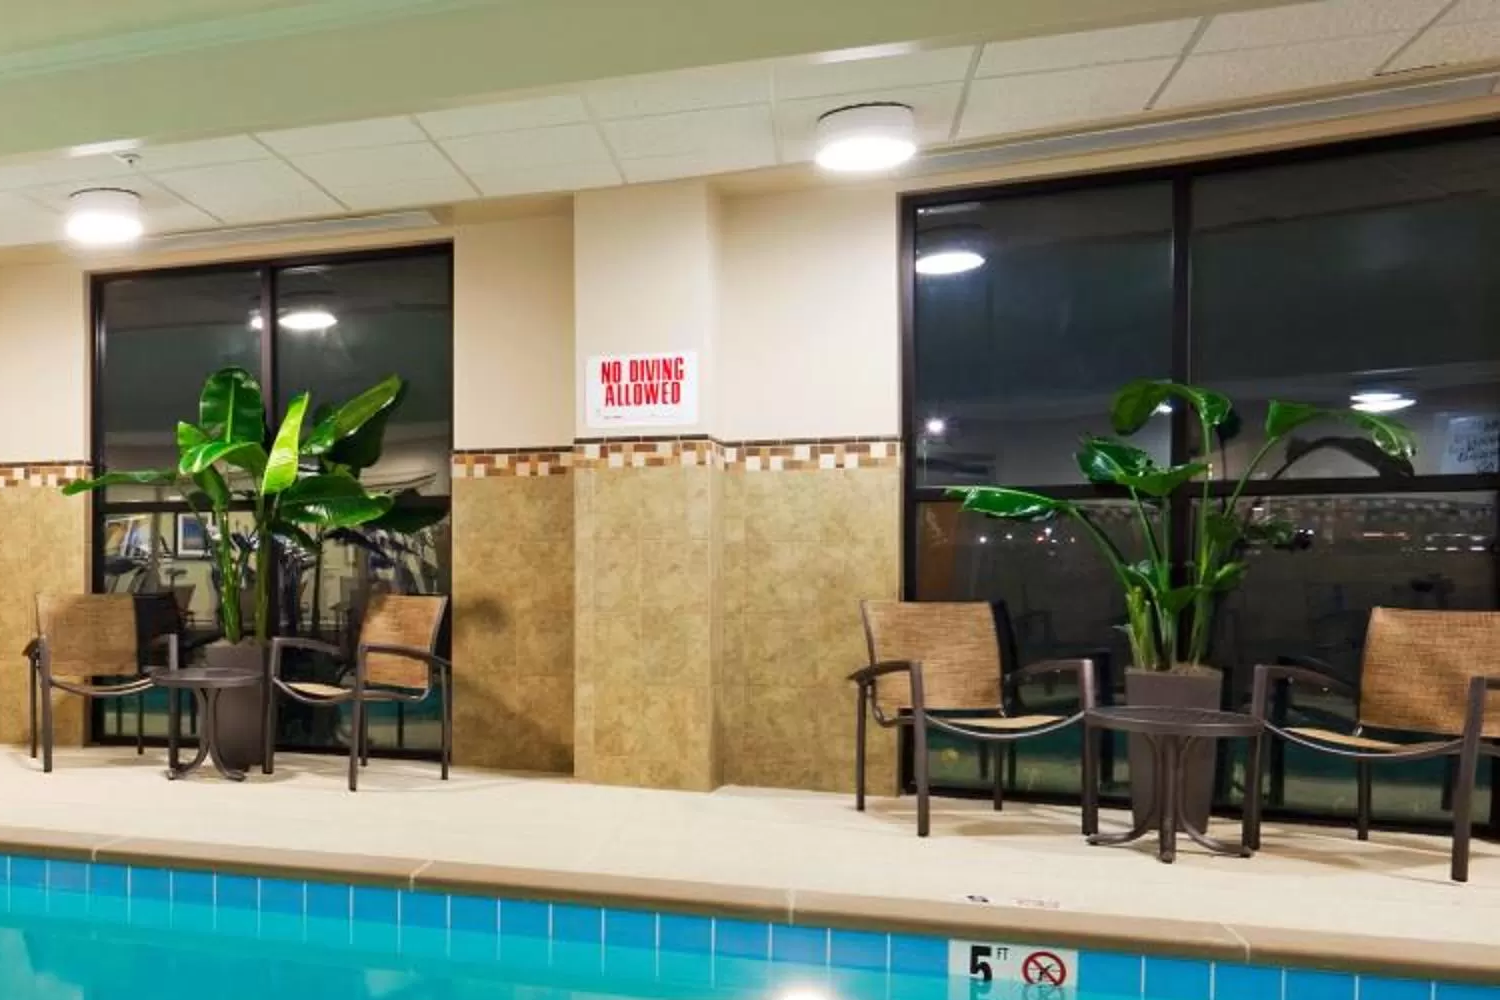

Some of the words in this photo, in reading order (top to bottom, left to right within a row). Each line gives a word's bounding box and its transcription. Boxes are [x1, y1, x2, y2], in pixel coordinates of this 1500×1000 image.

[601, 361, 622, 384] NO
[629, 357, 684, 382] DIVING
[605, 381, 681, 407] ALLOWED
[969, 945, 993, 982] 5
